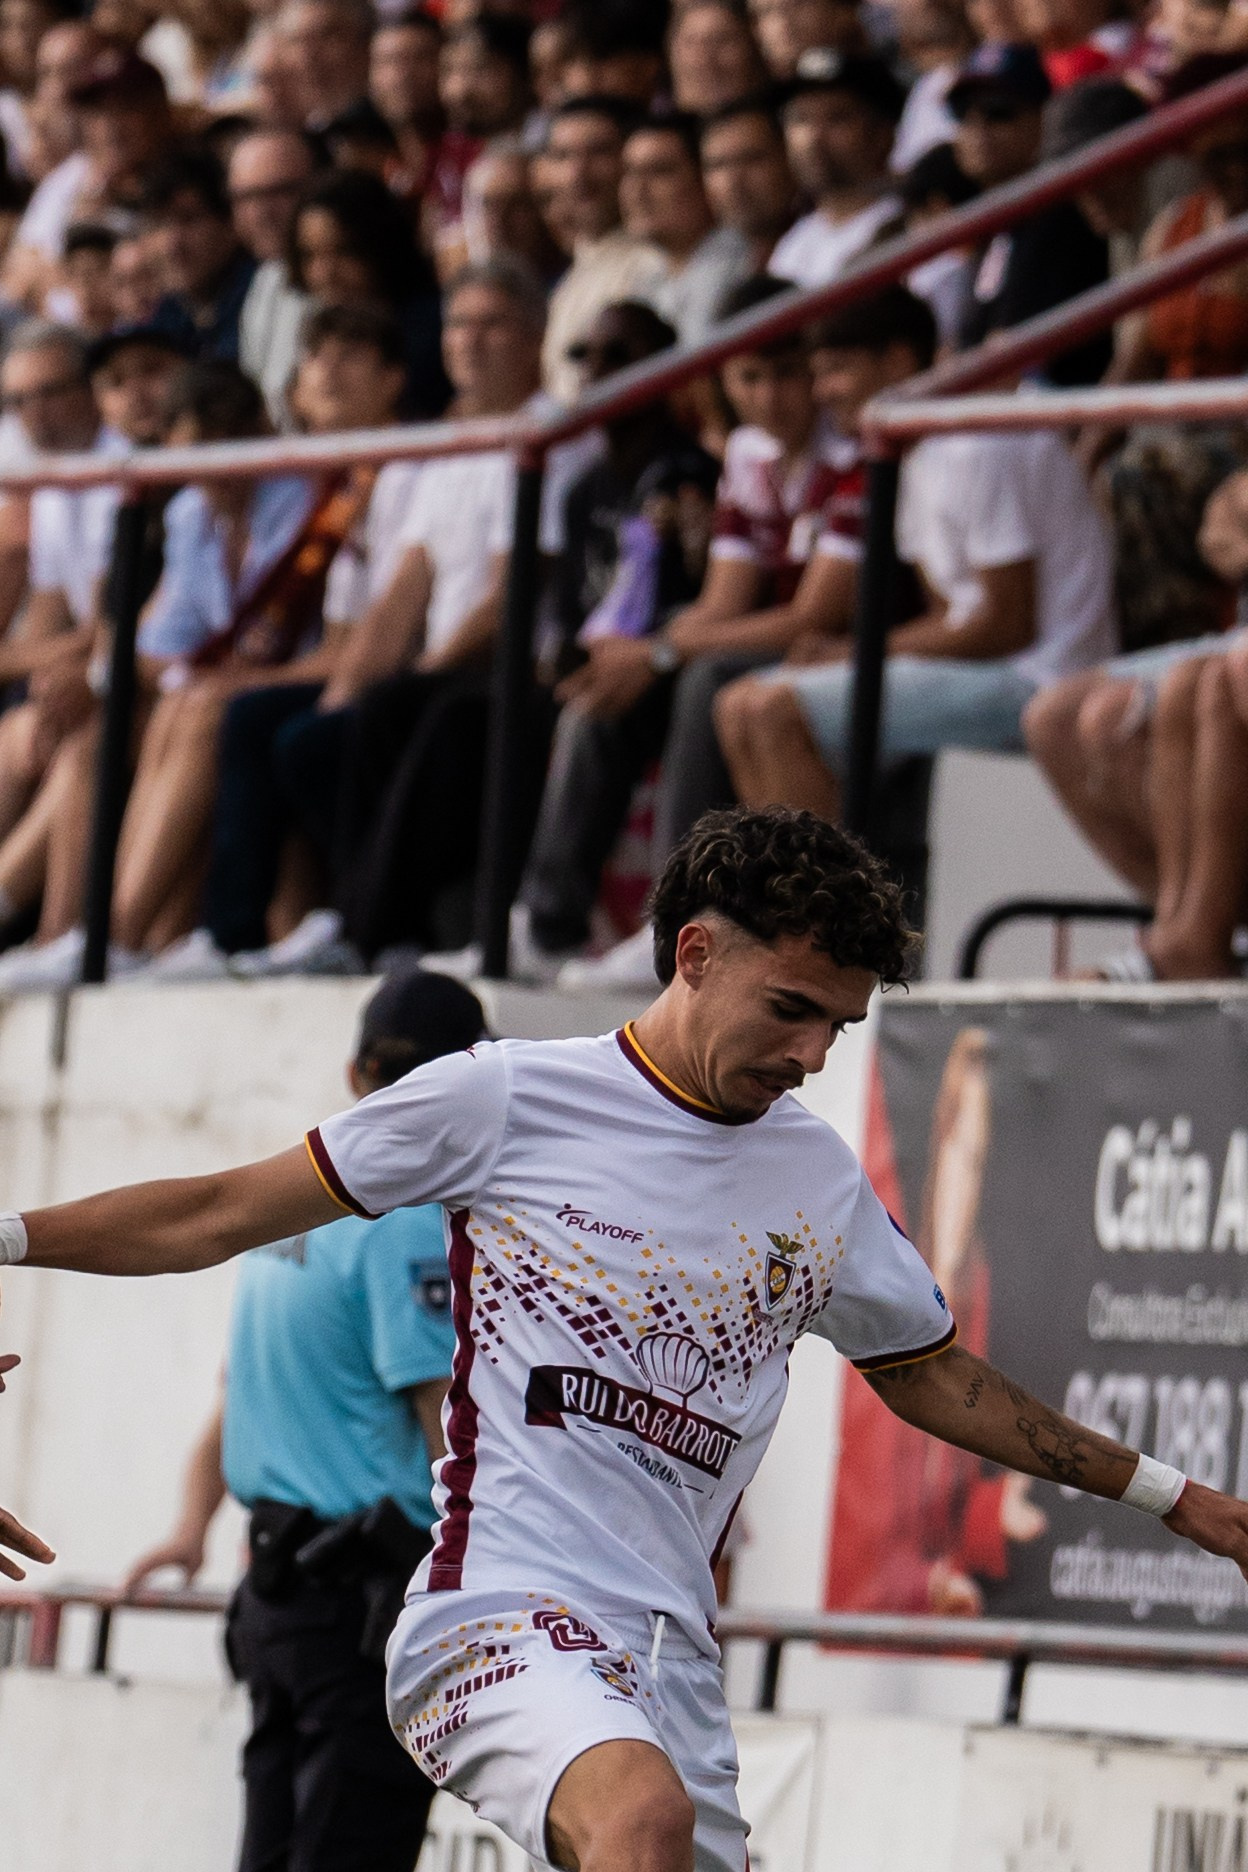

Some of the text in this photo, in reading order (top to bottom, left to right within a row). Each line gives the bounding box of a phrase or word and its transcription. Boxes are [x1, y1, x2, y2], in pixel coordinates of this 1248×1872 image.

[565, 1215, 644, 1244] PLAYOFF
[561, 1373, 609, 1417] RUI
[613, 1389, 649, 1433] DO
